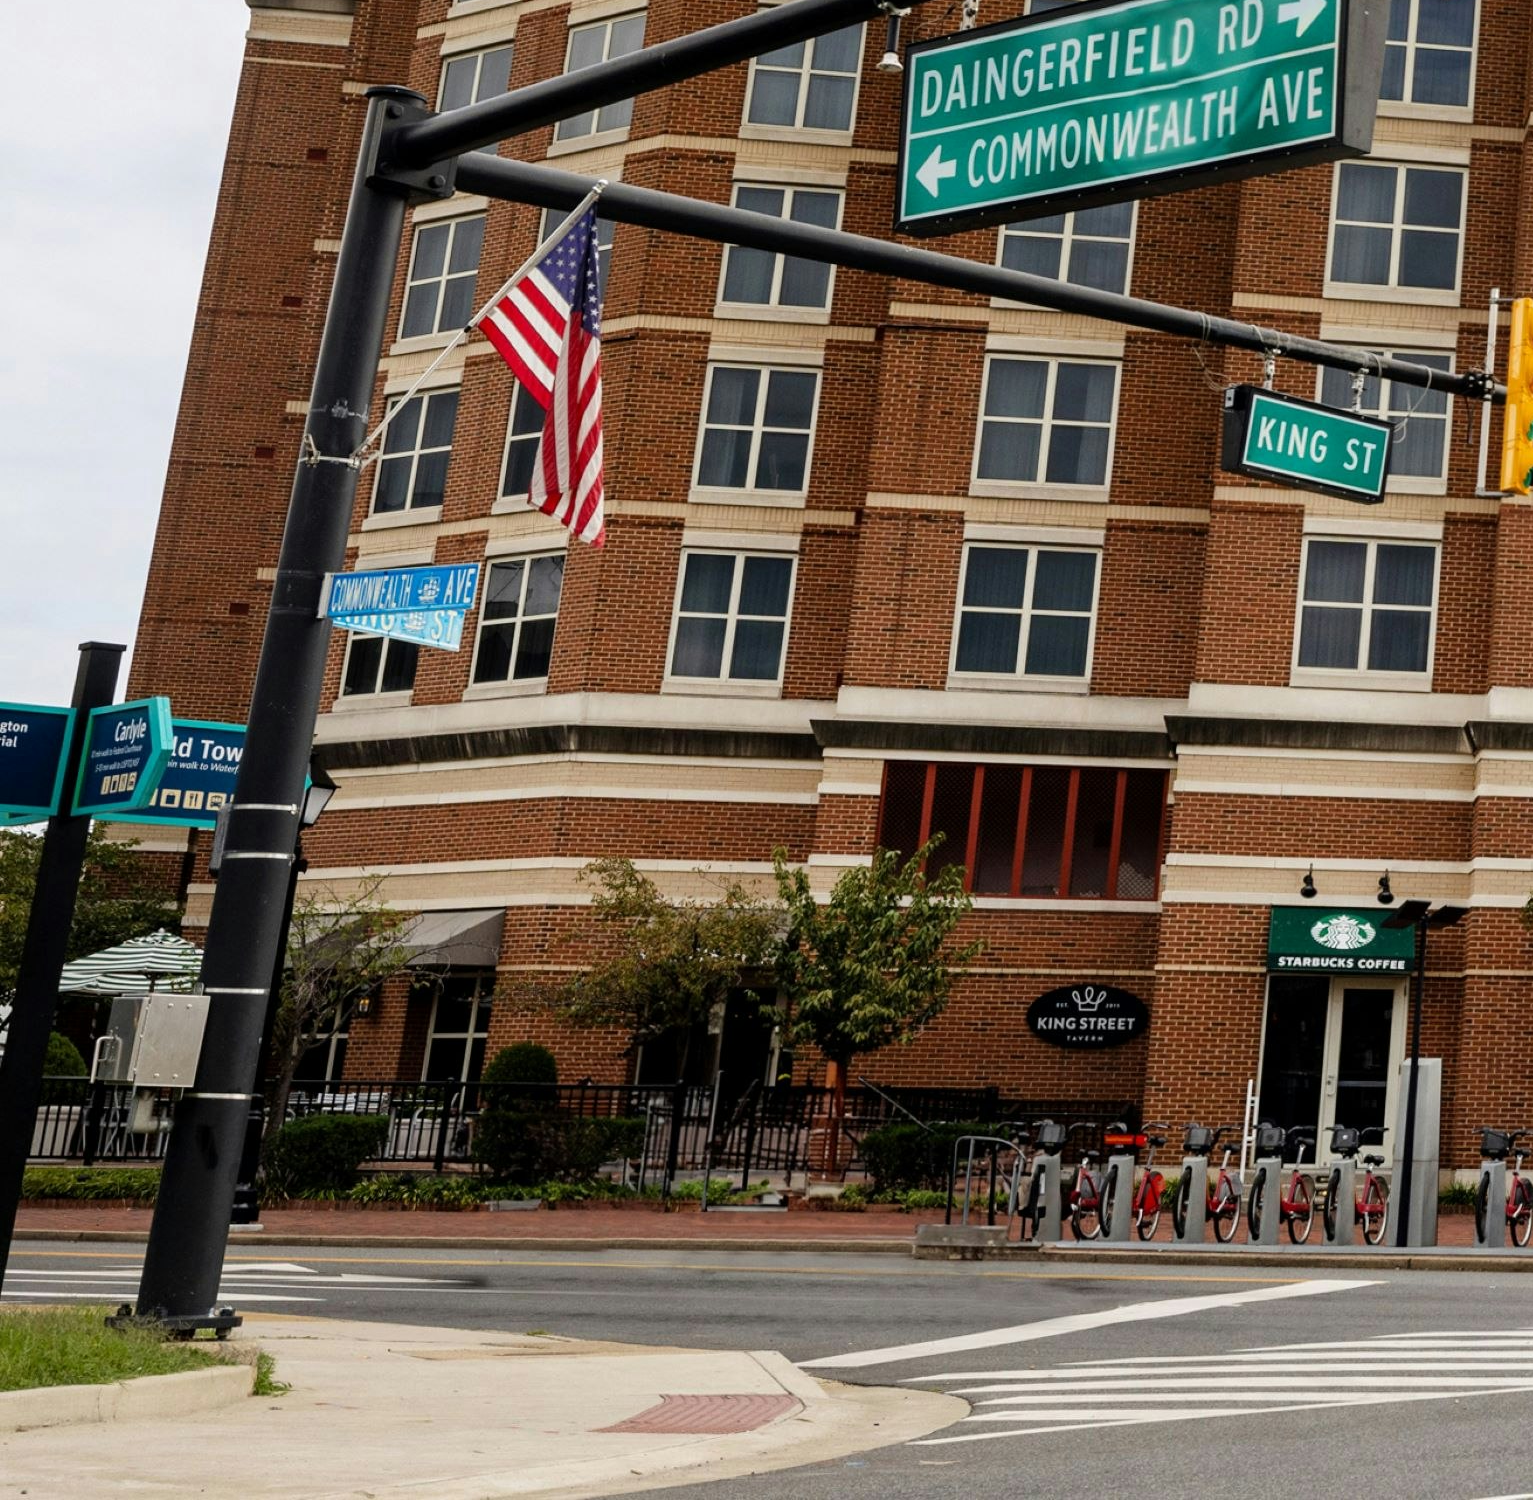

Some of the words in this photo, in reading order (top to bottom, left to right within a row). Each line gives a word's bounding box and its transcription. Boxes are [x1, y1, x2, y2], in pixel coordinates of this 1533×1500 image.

[920, 16, 1196, 118] DAINGERFIELD
[967, 85, 1239, 188] COMMONWEALTH
[1257, 66, 1325, 130] AVE
[1257, 416, 1328, 463] KING
[1343, 438, 1377, 474] ST
[331, 574, 414, 612] COMMONWEALTH
[443, 568, 476, 605] AVE
[430, 609, 458, 641] ST
[0, 735, 18, 748] ial
[114, 717, 147, 744] Carlyle
[171, 736, 194, 758] ld
[201, 739, 244, 762] Tow
[180, 761, 198, 770] walk
[200, 763, 209, 771] to
[210, 763, 239, 775] Waterf
[1277, 956, 1354, 969] STARBUCKS
[1357, 959, 1406, 970] COFFEE
[1037, 1017, 1077, 1030] KING
[1079, 1017, 1136, 1030] STREET
